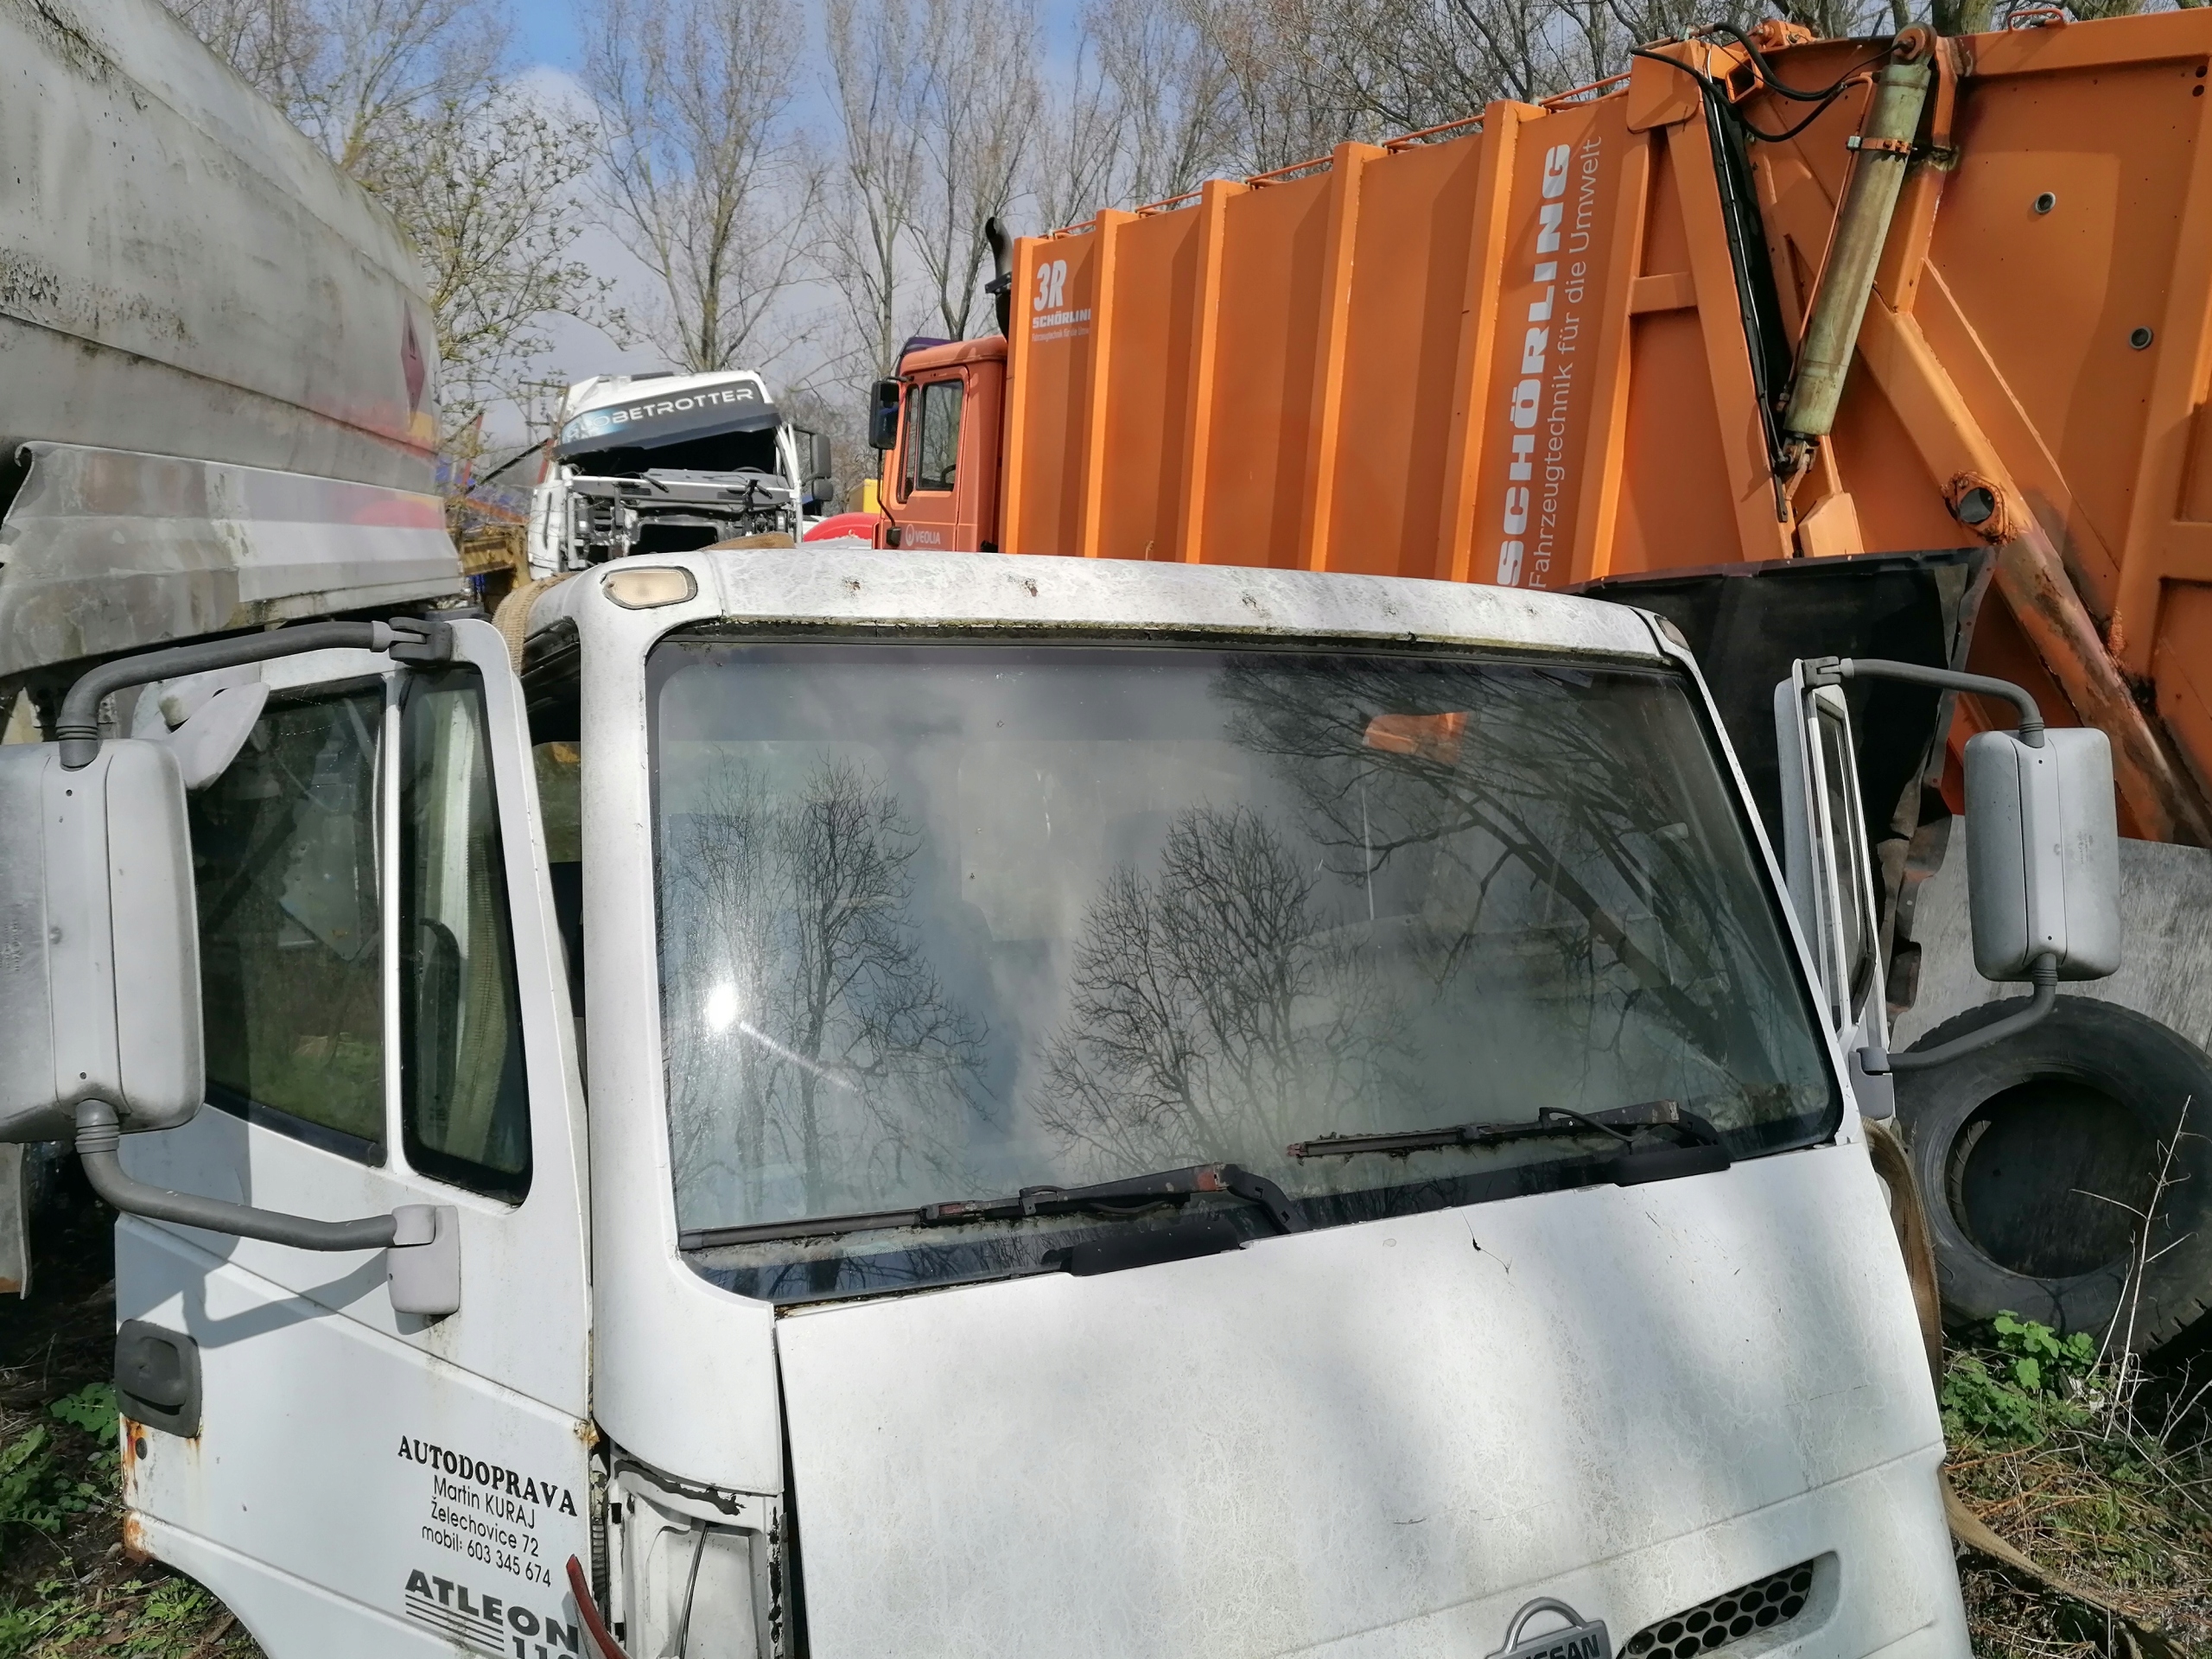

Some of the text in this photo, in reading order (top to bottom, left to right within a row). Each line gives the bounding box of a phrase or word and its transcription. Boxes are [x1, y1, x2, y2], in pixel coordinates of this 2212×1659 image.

[1033, 259, 1067, 311] 3R
[1497, 143, 1571, 587] SCHÖRLING
[1528, 136, 1602, 588] Fahrzeugtechnik für die Umwelt
[915, 530, 941, 545] VEOLIA
[397, 1434, 577, 1517] AUTODOPRAVA
[434, 1474, 535, 1529] Martin KURAJ
[422, 1525, 551, 1588] mobil: 603 345 674
[431, 1495, 539, 1557] Želechovice 72
[404, 1568, 579, 1656] ATLEON
